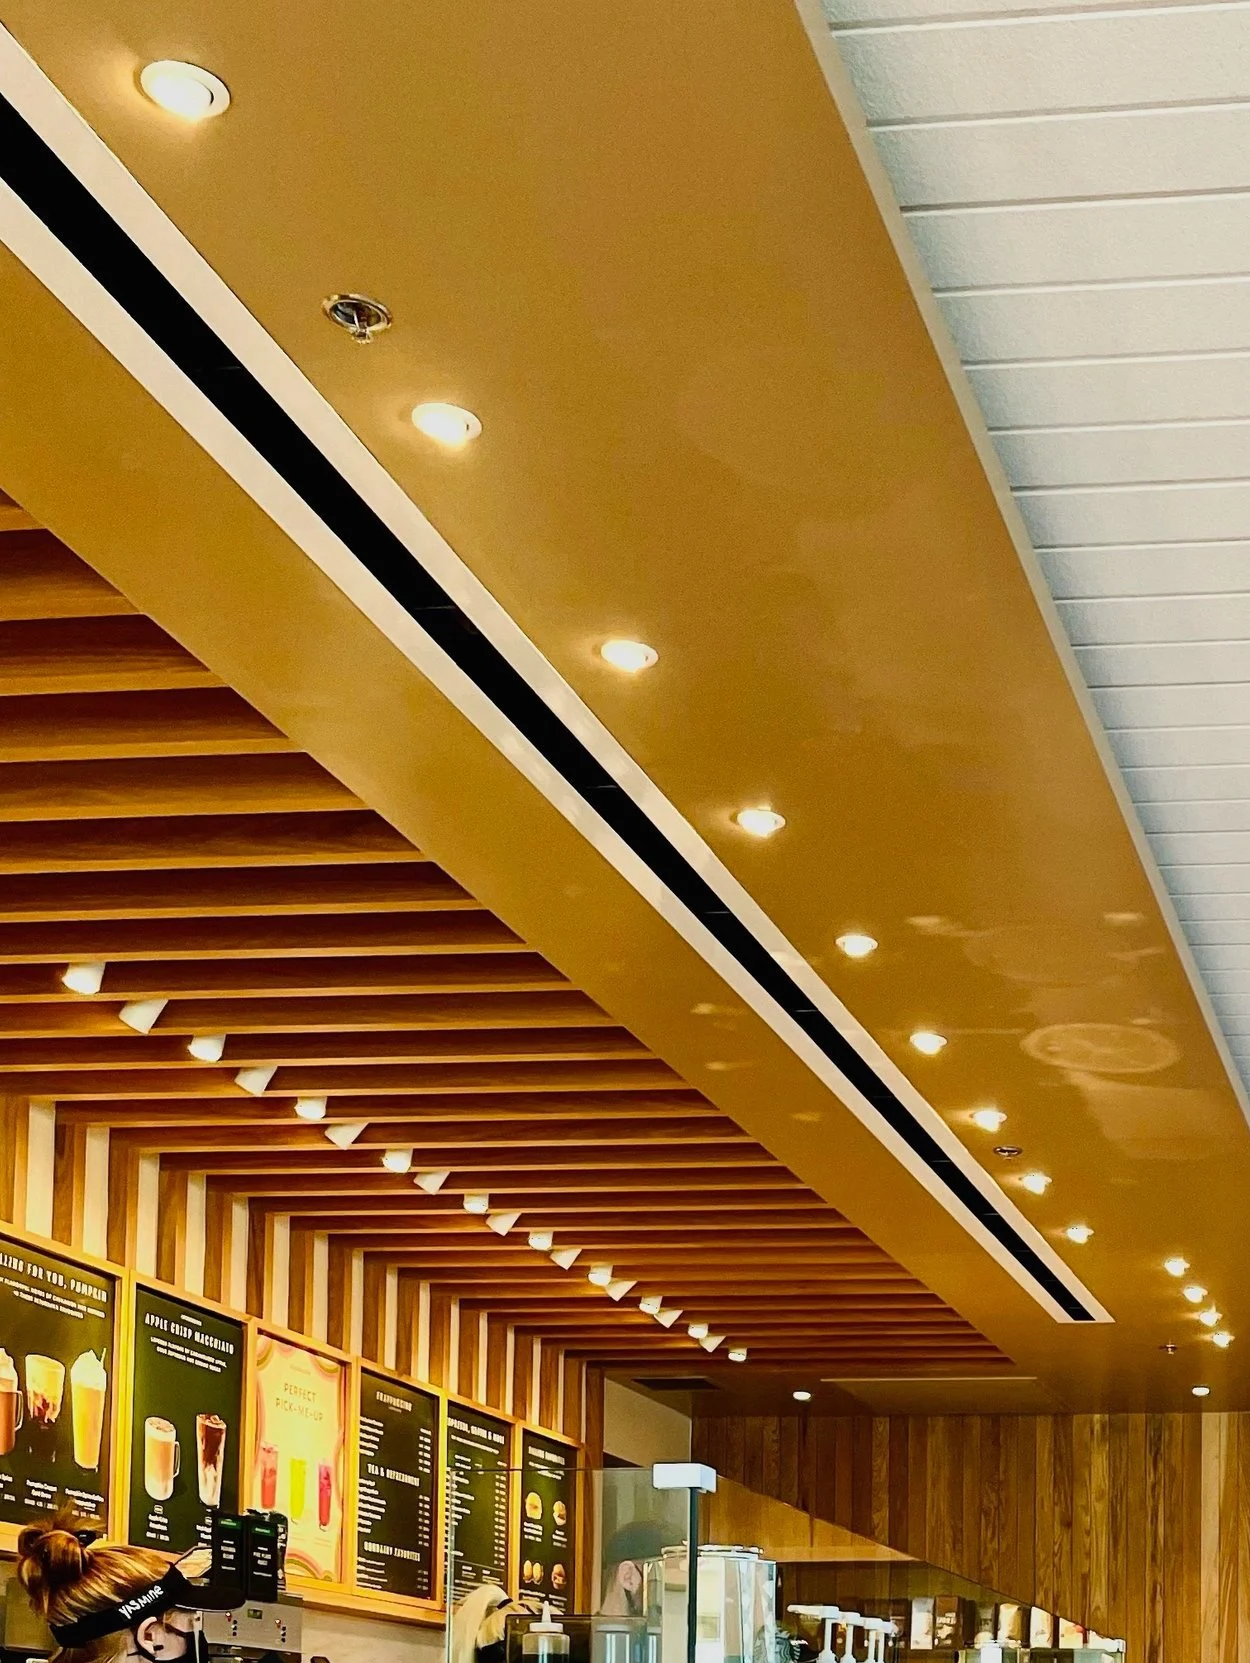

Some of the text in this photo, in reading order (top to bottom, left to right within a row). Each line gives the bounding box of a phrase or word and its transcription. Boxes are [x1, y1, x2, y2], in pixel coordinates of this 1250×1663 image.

[27, 1263, 44, 1280] FOR
[70, 1279, 107, 1303] PUMPKIN
[145, 1312, 169, 1332] APPLE
[170, 1321, 193, 1340] CRISP
[284, 1383, 317, 1403] PERFECT
[275, 1397, 324, 1422] PICK-ME-UP
